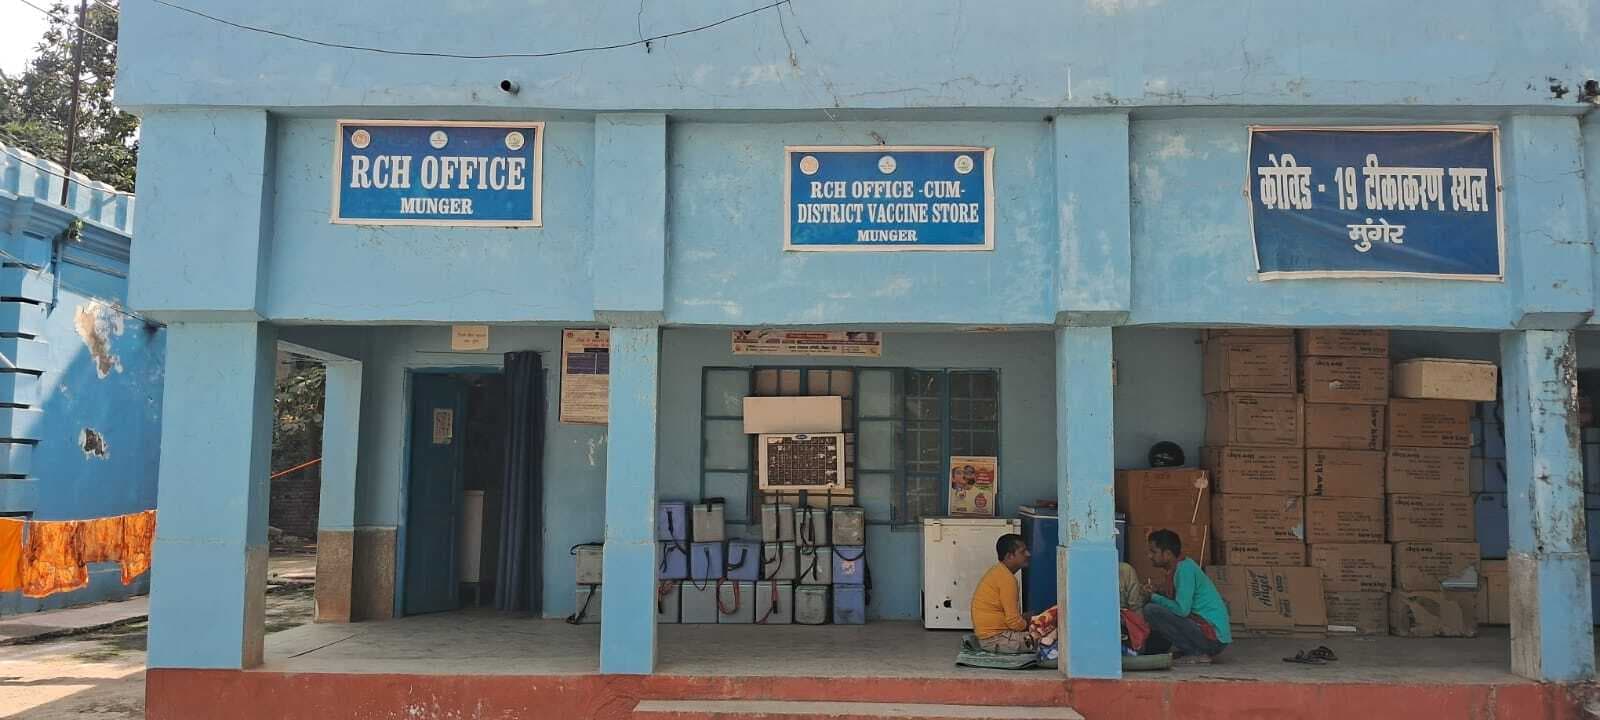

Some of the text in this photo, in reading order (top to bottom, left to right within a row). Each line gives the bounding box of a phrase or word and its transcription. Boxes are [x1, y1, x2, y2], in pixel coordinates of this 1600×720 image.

[350, 155, 526, 191] RCH OFFICE
[1257, 153, 1312, 210] कोविड
[1334, 166, 1356, 210] 19
[1362, 153, 1445, 211] टीकाकरण
[1448, 167, 1489, 212] स्थल
[810, 181, 966, 199] RCH OFFICE -CUM-
[400, 197, 473, 215] MUNGER
[797, 203, 979, 224] DISTRICT VACCINE STORE
[857, 229, 917, 242] MUNGER
[1346, 217, 1406, 253] मुंगेर
